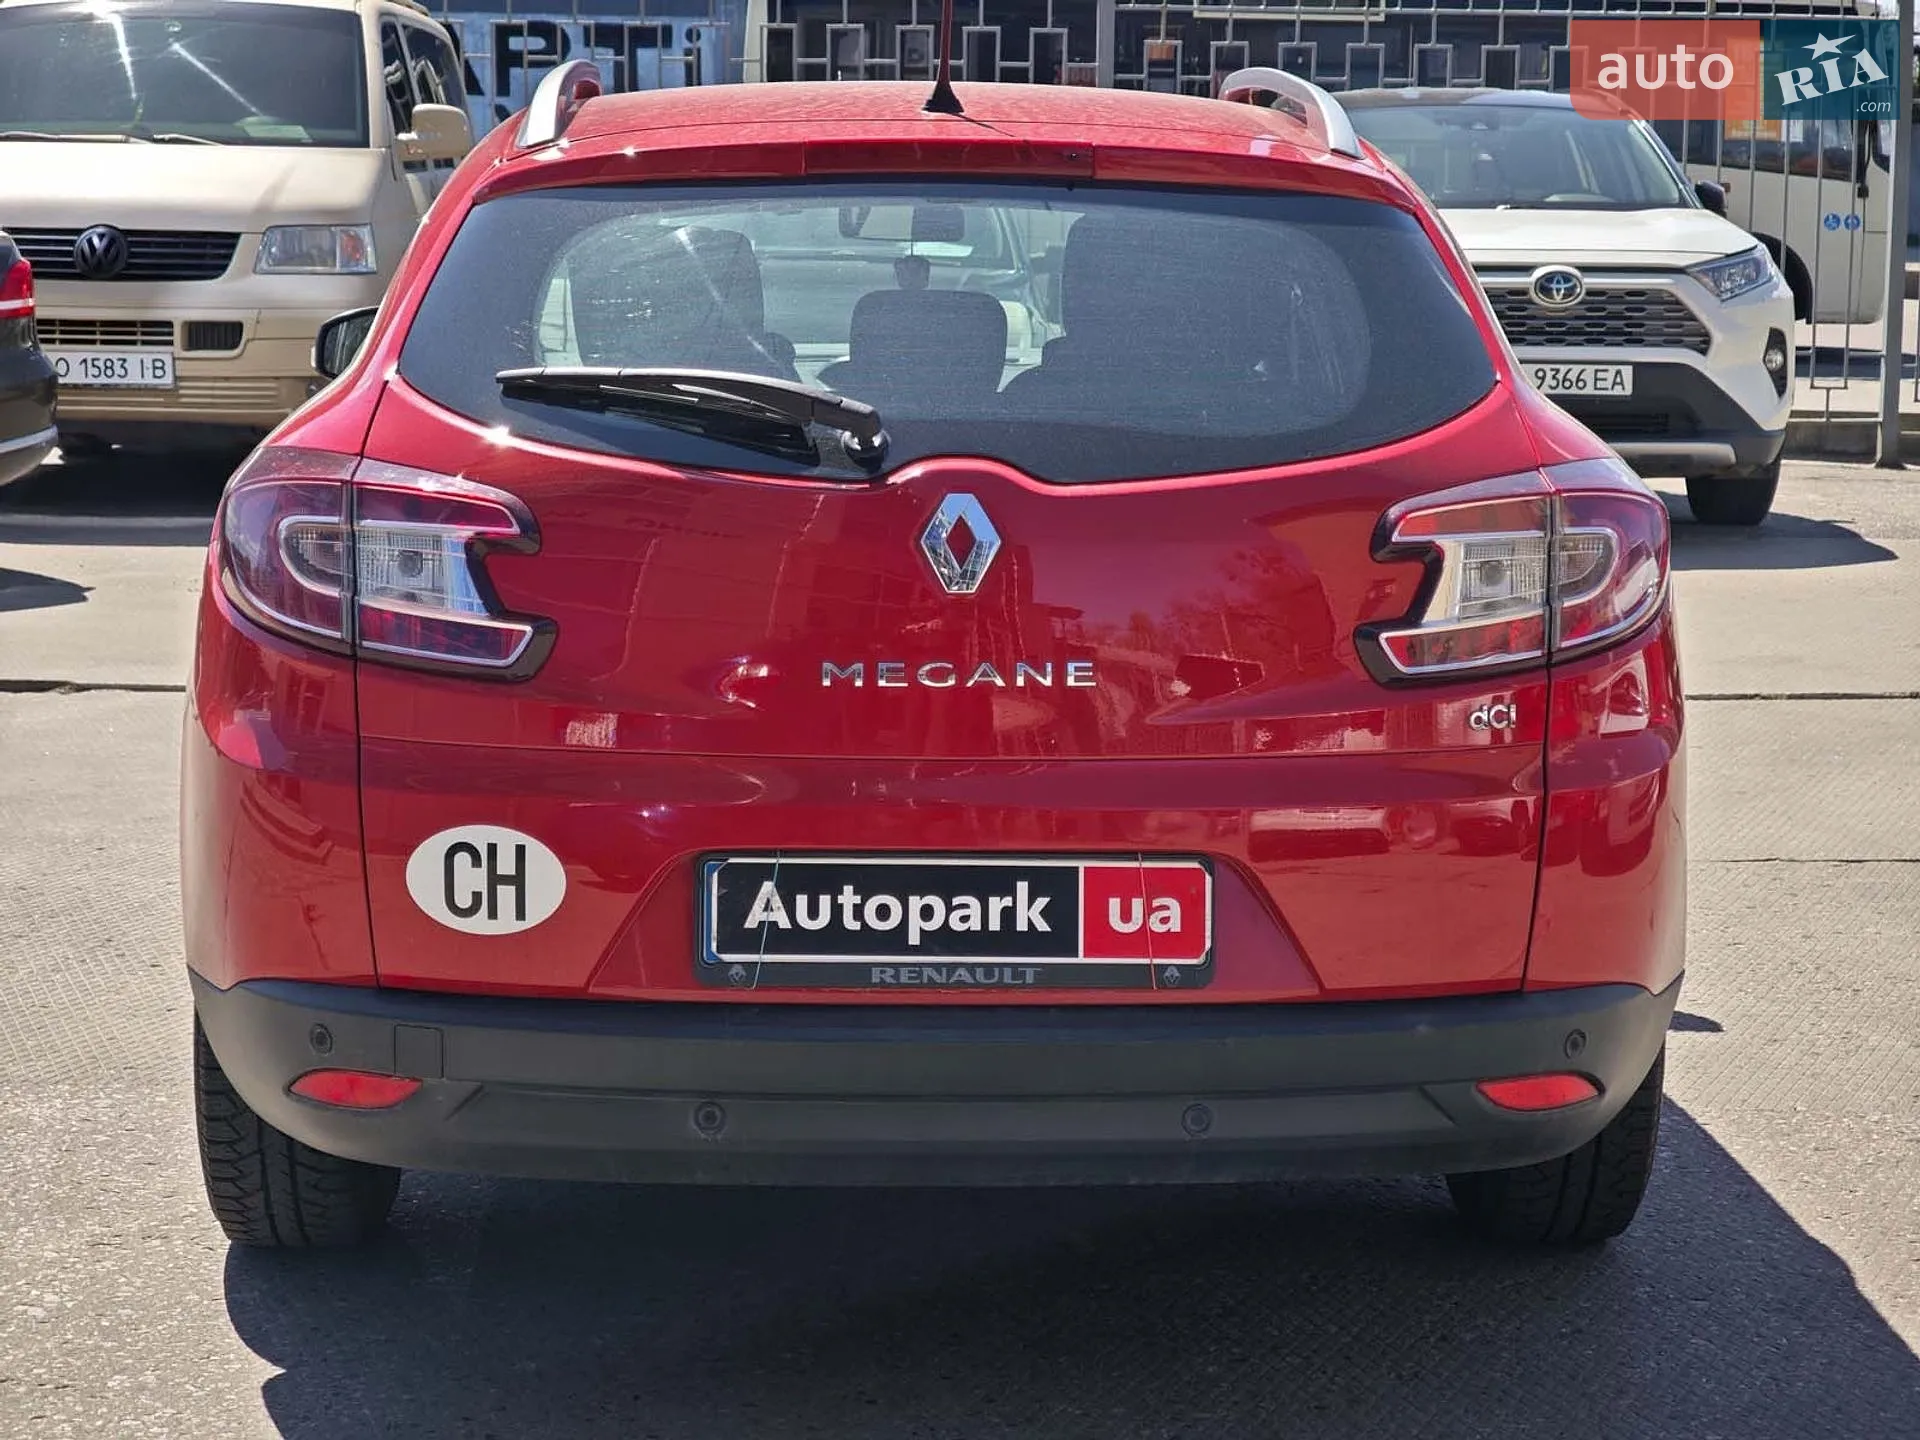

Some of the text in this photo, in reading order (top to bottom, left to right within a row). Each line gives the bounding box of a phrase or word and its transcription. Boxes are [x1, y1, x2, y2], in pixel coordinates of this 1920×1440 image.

[79, 357, 129, 379] 1583
[140, 358, 167, 379] IB
[1534, 367, 1626, 391] 9366 EA
[821, 662, 1097, 687] MEGANE
[443, 841, 526, 922] CH
[743, 880, 1182, 946] Autopark ua
[871, 966, 1043, 985] RENAULT
